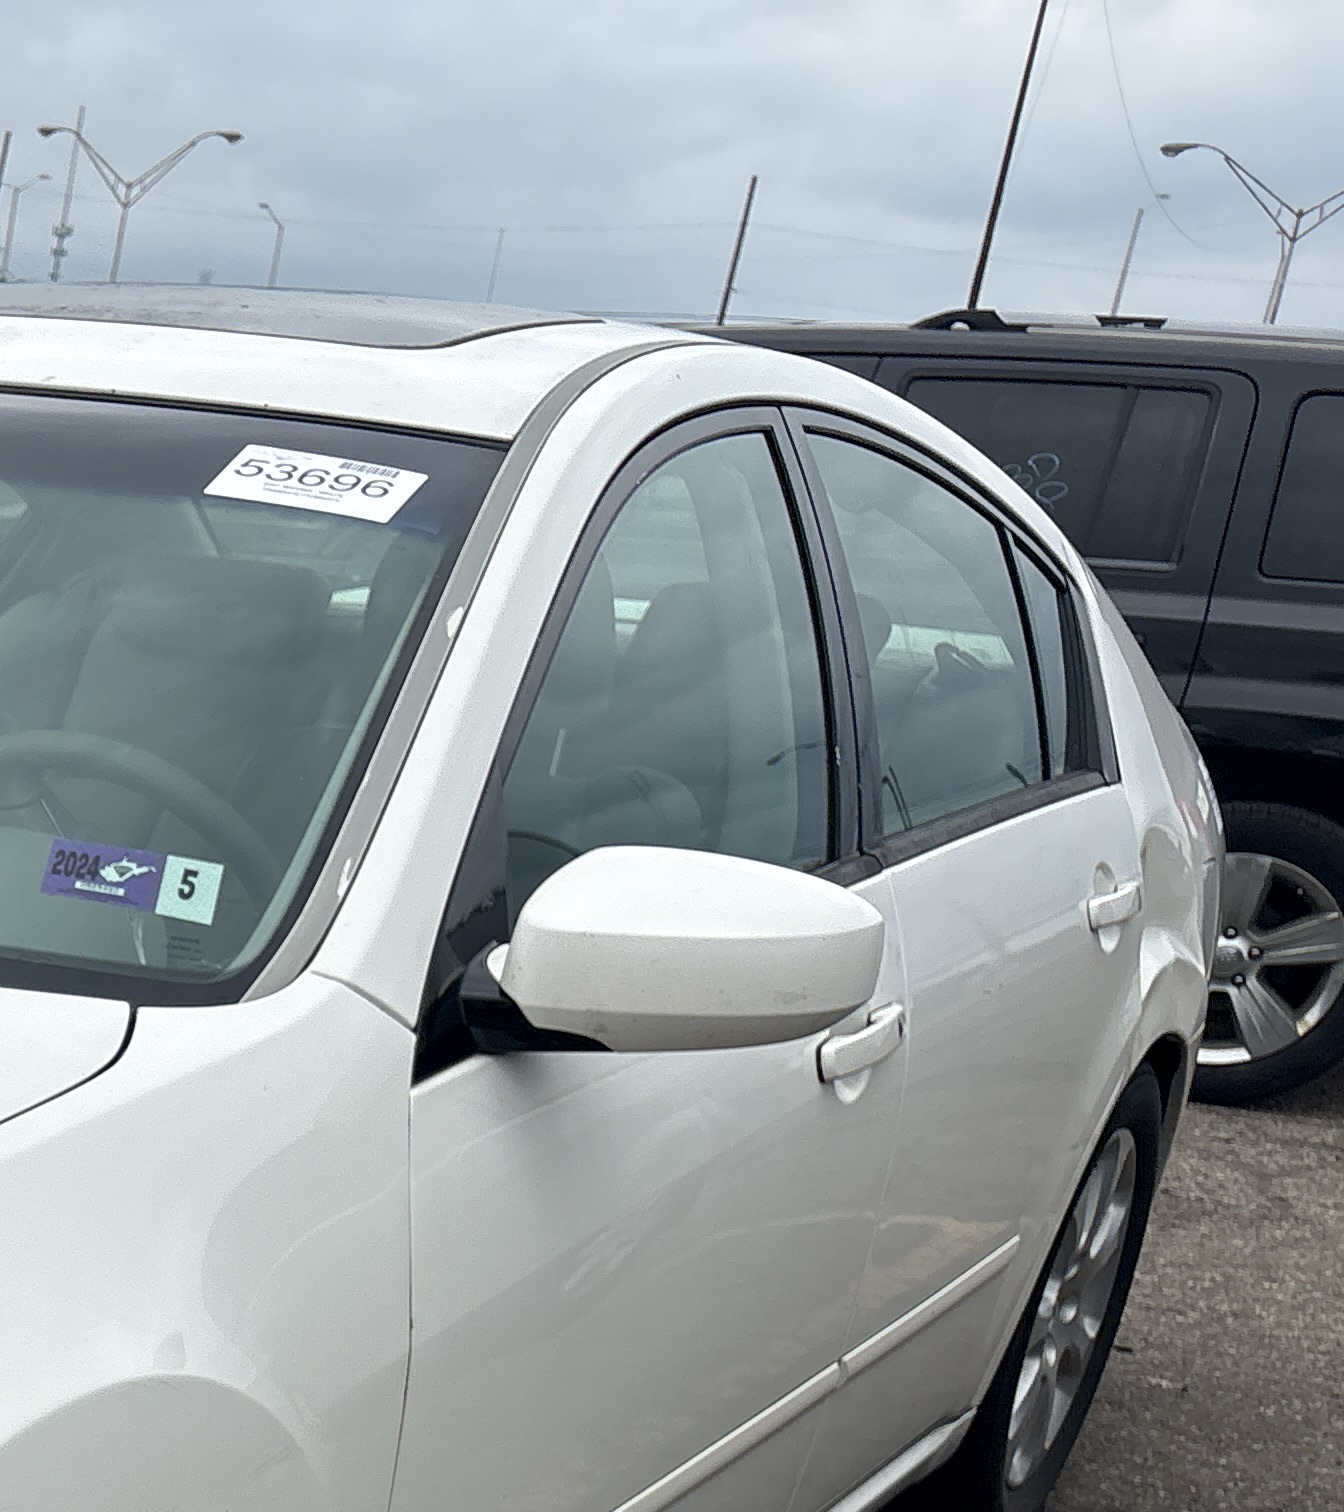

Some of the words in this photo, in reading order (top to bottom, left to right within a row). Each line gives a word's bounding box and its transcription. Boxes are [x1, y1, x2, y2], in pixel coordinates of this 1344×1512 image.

[233, 458, 394, 499] 53696
[51, 849, 101, 881] 2024
[177, 868, 199, 900] 5
